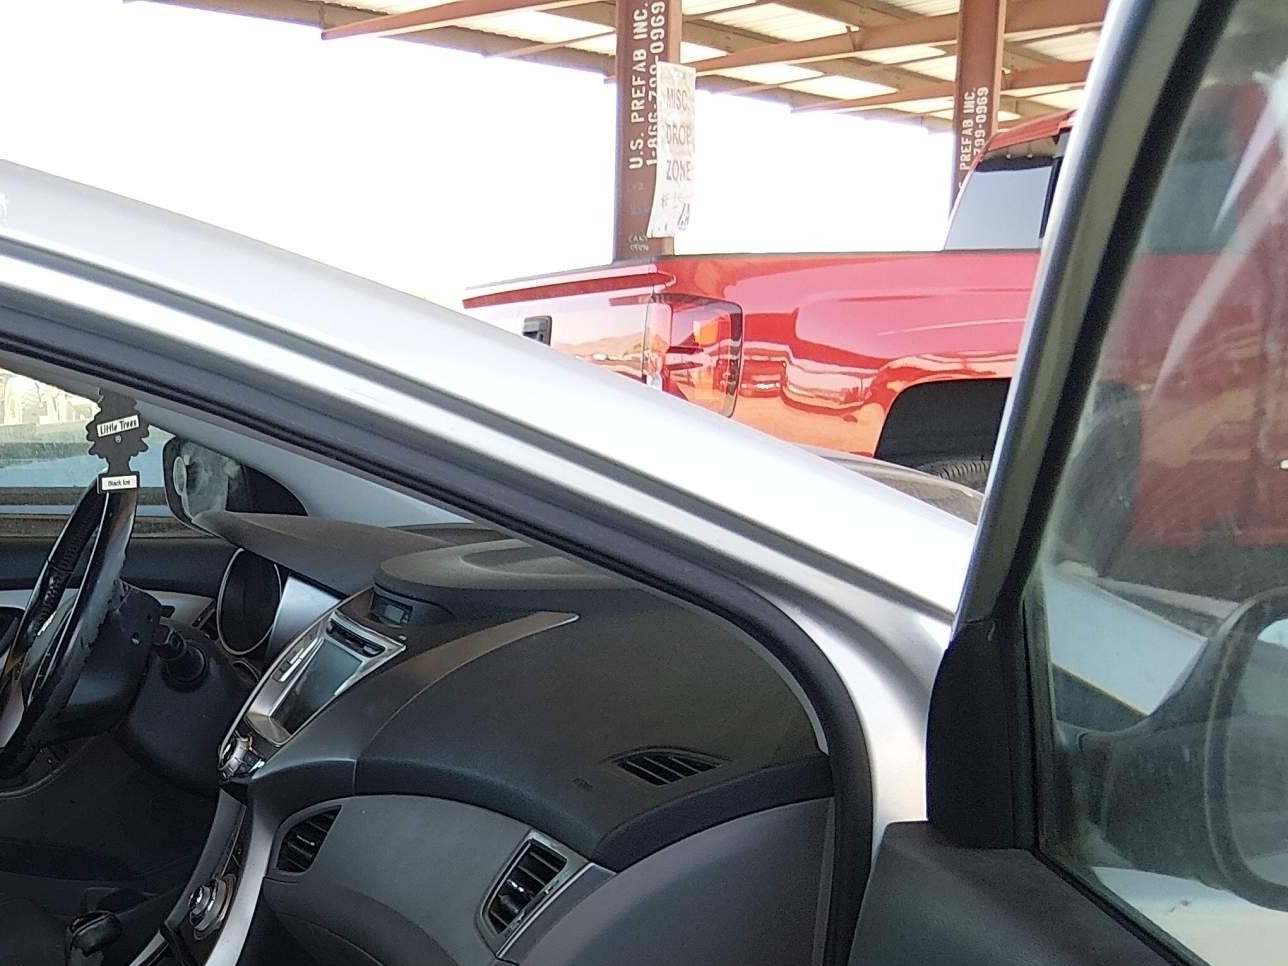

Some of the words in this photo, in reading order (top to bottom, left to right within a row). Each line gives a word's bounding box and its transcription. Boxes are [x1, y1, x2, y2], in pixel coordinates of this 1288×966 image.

[633, 2, 648, 40] INC.
[631, 49, 647, 123] PREFAB
[629, 132, 645, 169] U.S.
[665, 123, 691, 145] DROP
[959, 119, 974, 171] PREFAB
[665, 160, 691, 181] ZONE
[99, 420, 118, 435] Little
[119, 418, 138, 431] Trees
